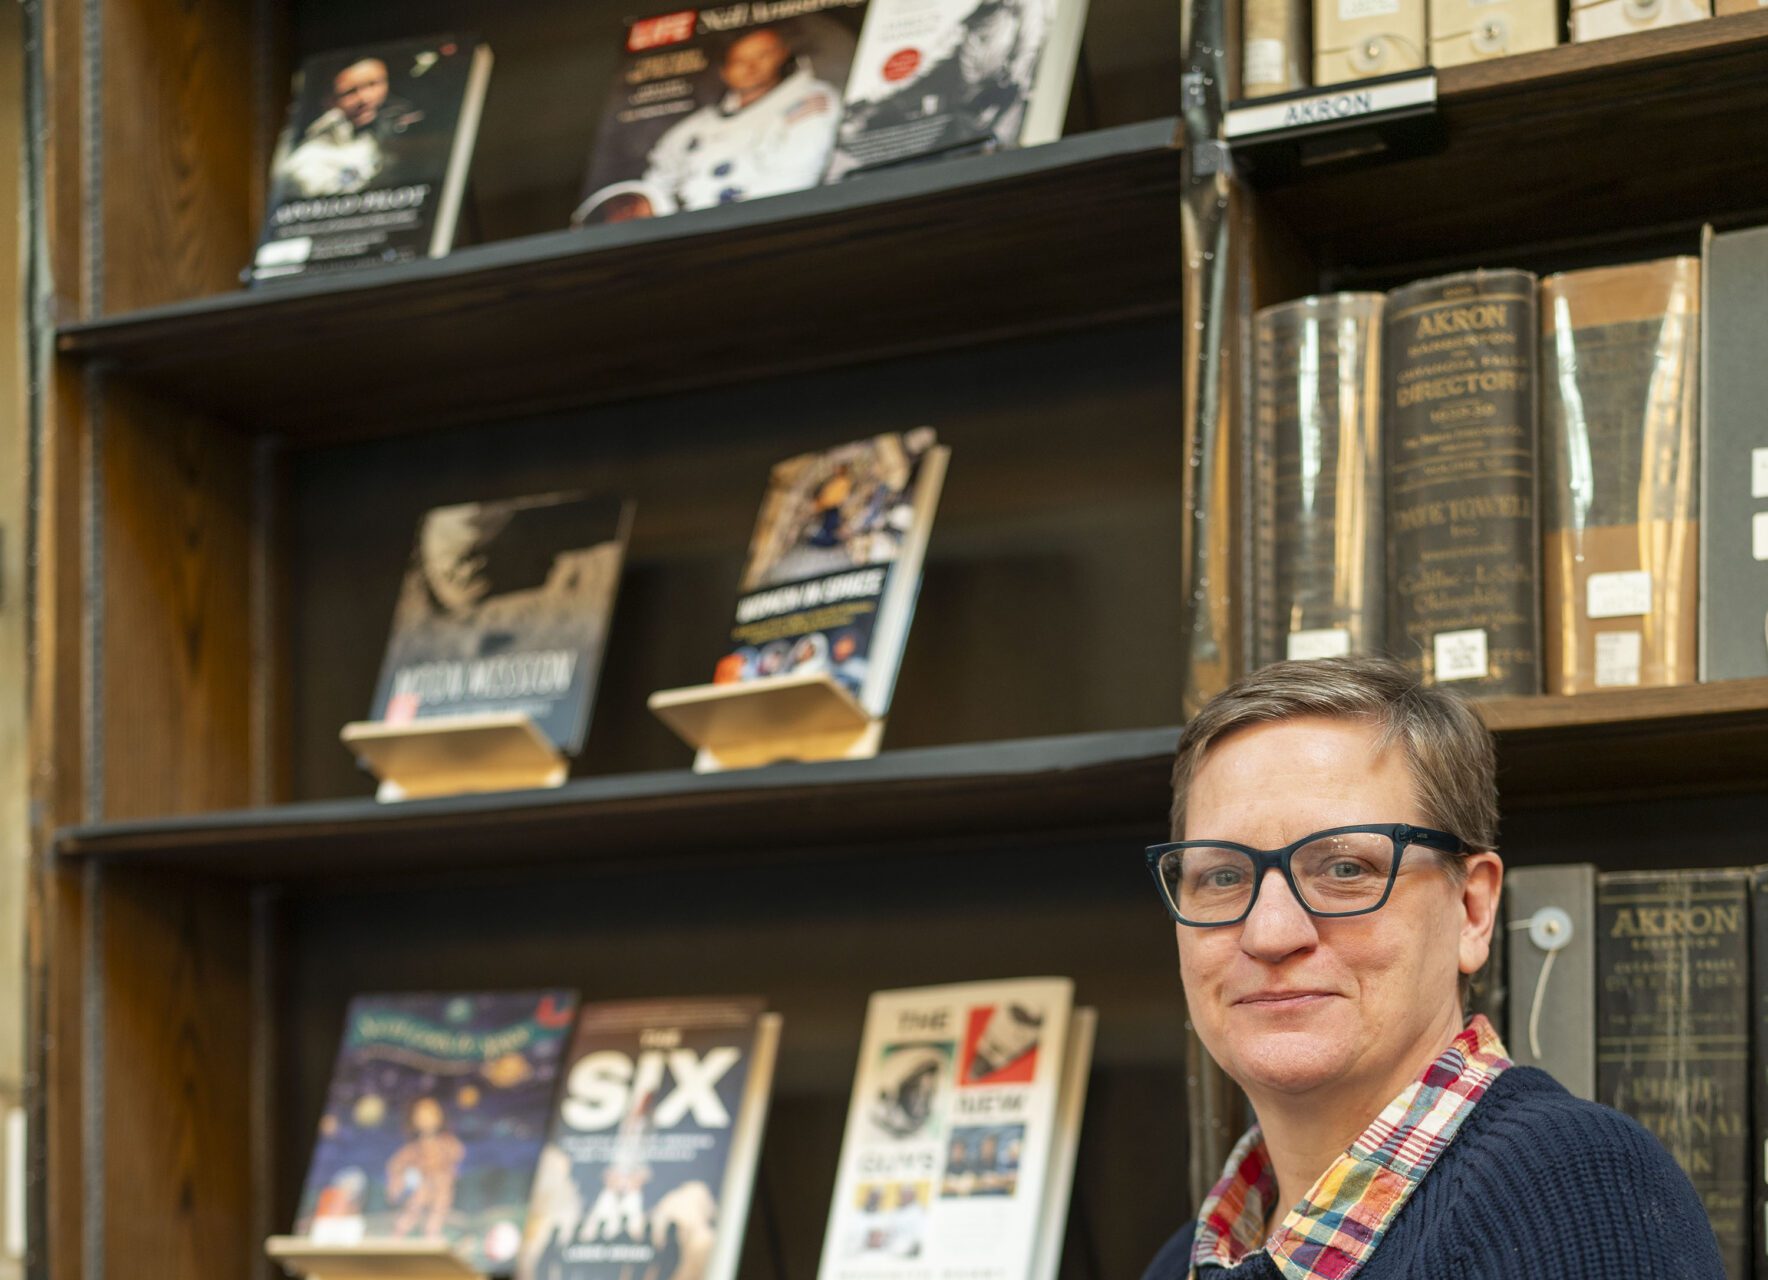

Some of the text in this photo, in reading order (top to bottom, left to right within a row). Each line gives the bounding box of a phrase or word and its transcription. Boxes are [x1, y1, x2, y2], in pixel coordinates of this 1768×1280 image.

[1284, 91, 1374, 127] AKRON
[1416, 305, 1507, 338] AKRON
[1611, 904, 1741, 938] AKRON
[897, 1007, 951, 1030] THE
[561, 1047, 741, 1132] SIX
